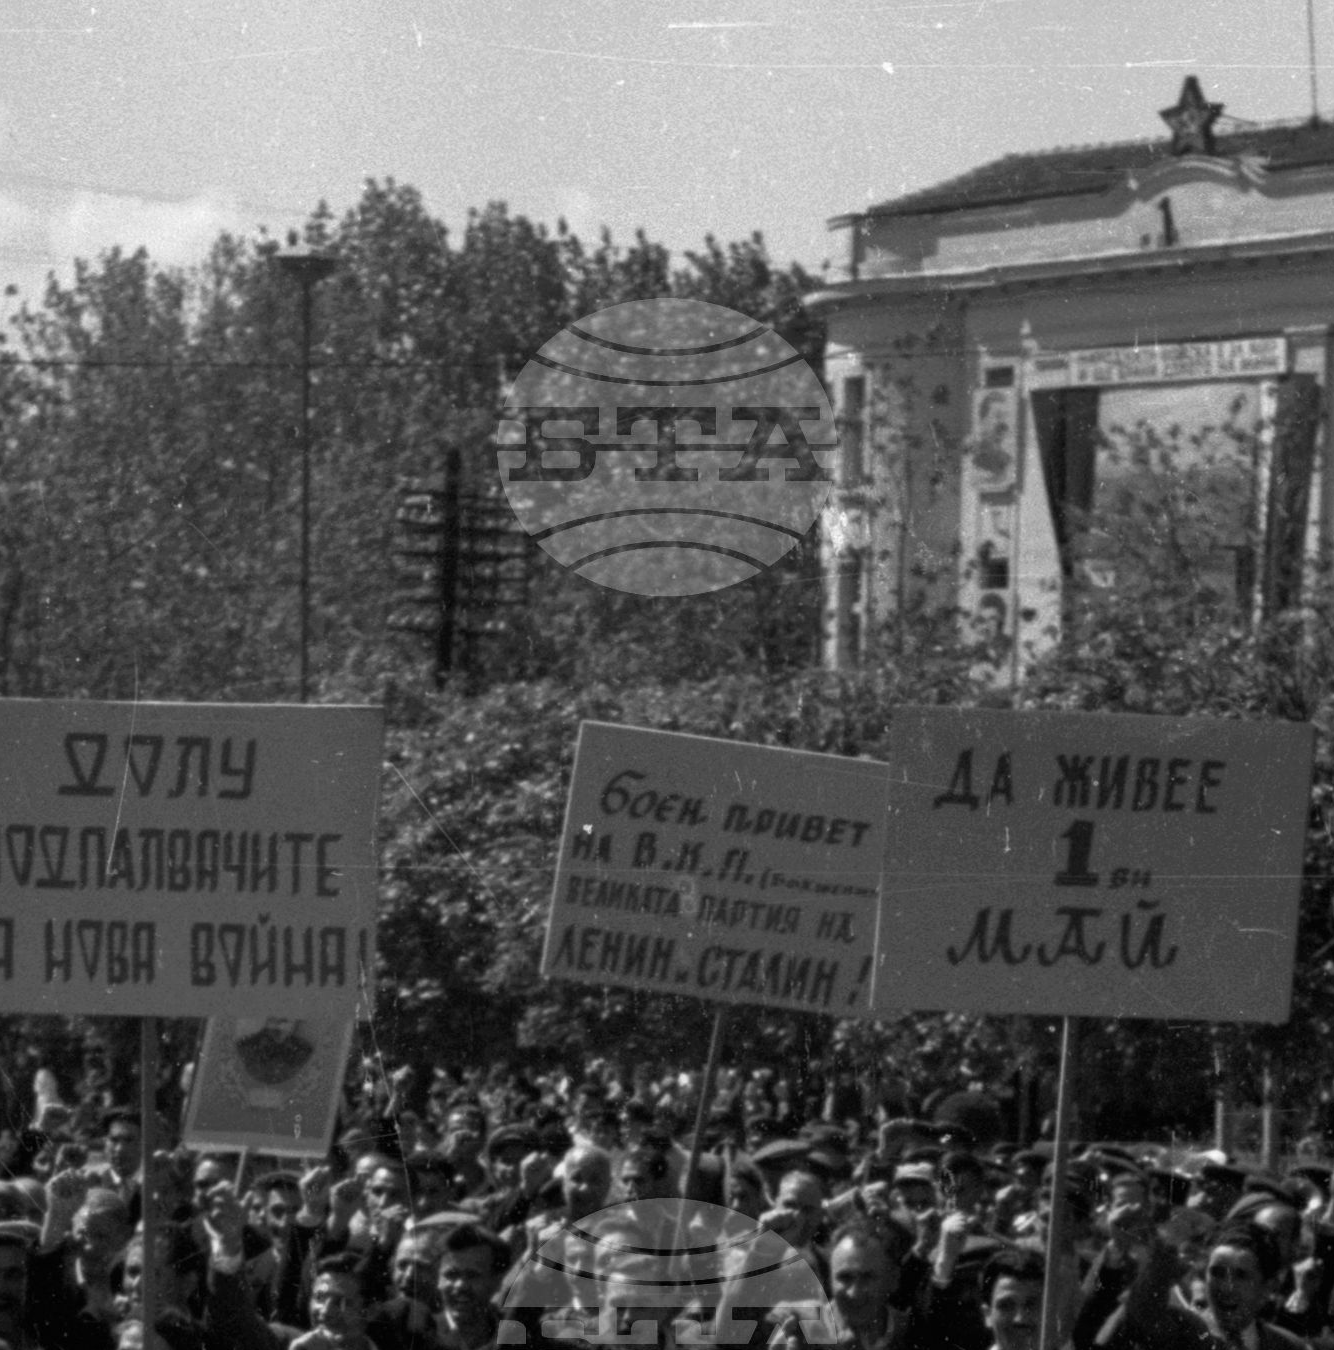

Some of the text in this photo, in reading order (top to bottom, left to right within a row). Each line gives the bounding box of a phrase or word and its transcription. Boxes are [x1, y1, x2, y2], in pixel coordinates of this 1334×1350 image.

[57, 732, 257, 799] ДОЛУ
[932, 746, 1227, 815] ДА ЖИВЕЕ
[571, 833, 612, 863] НА
[1053, 818, 1100, 888] 1
[43, 918, 157, 985] НОВА
[552, 922, 676, 981] ЛЕНИН
[696, 894, 802, 935] ПАРТИЯ
[816, 910, 856, 944] НА
[946, 898, 1179, 970] МАЙ
